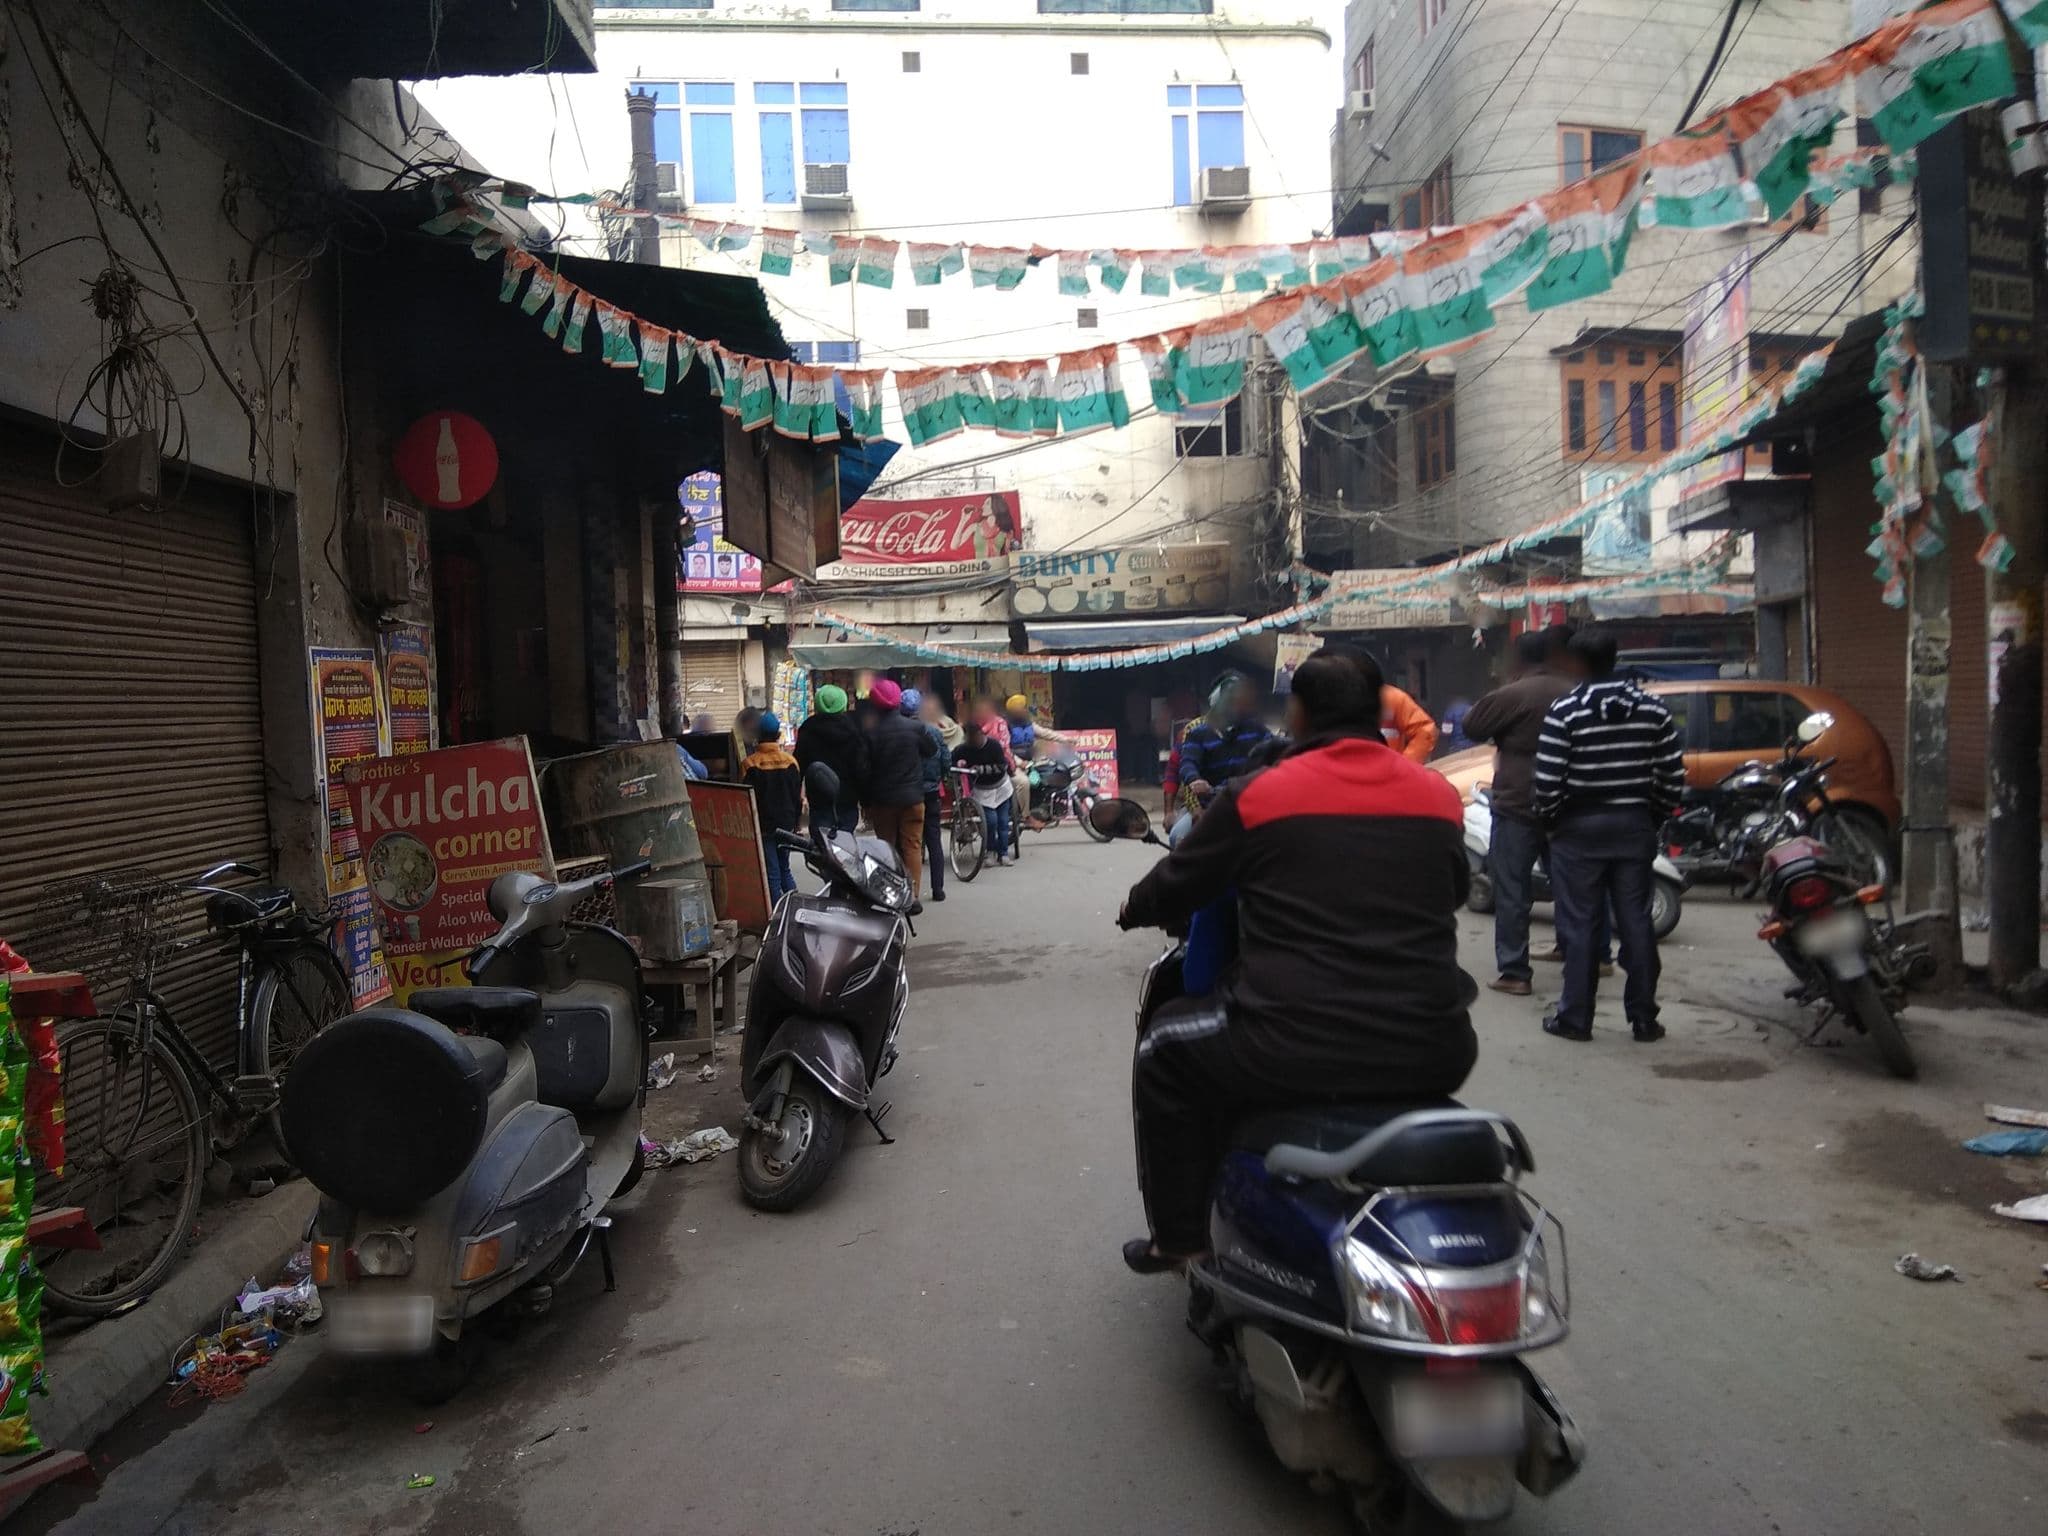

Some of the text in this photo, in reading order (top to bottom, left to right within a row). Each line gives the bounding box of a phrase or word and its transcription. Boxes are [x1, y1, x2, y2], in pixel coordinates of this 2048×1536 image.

[841, 509, 951, 554] ca-Cola
[832, 560, 992, 577] DASHMESH COLD DRIN
[1018, 550, 1121, 578] BUNTY
[1131, 555, 1177, 569] KULCA
[1336, 608, 1445, 626] GUEST HOUSE
[1077, 732, 1114, 749] nty
[1088, 750, 1114, 761] Point
[360, 767, 530, 832] Kulcha
[435, 825, 536, 860] corner
[470, 866, 490, 878] With
[441, 887, 486, 908] Special
[469, 910, 496, 924] Wa
[385, 929, 499, 955] Paneer Wala Kul
[391, 960, 451, 988] Veg.
[1428, 1233, 1487, 1249] SUZUKI
